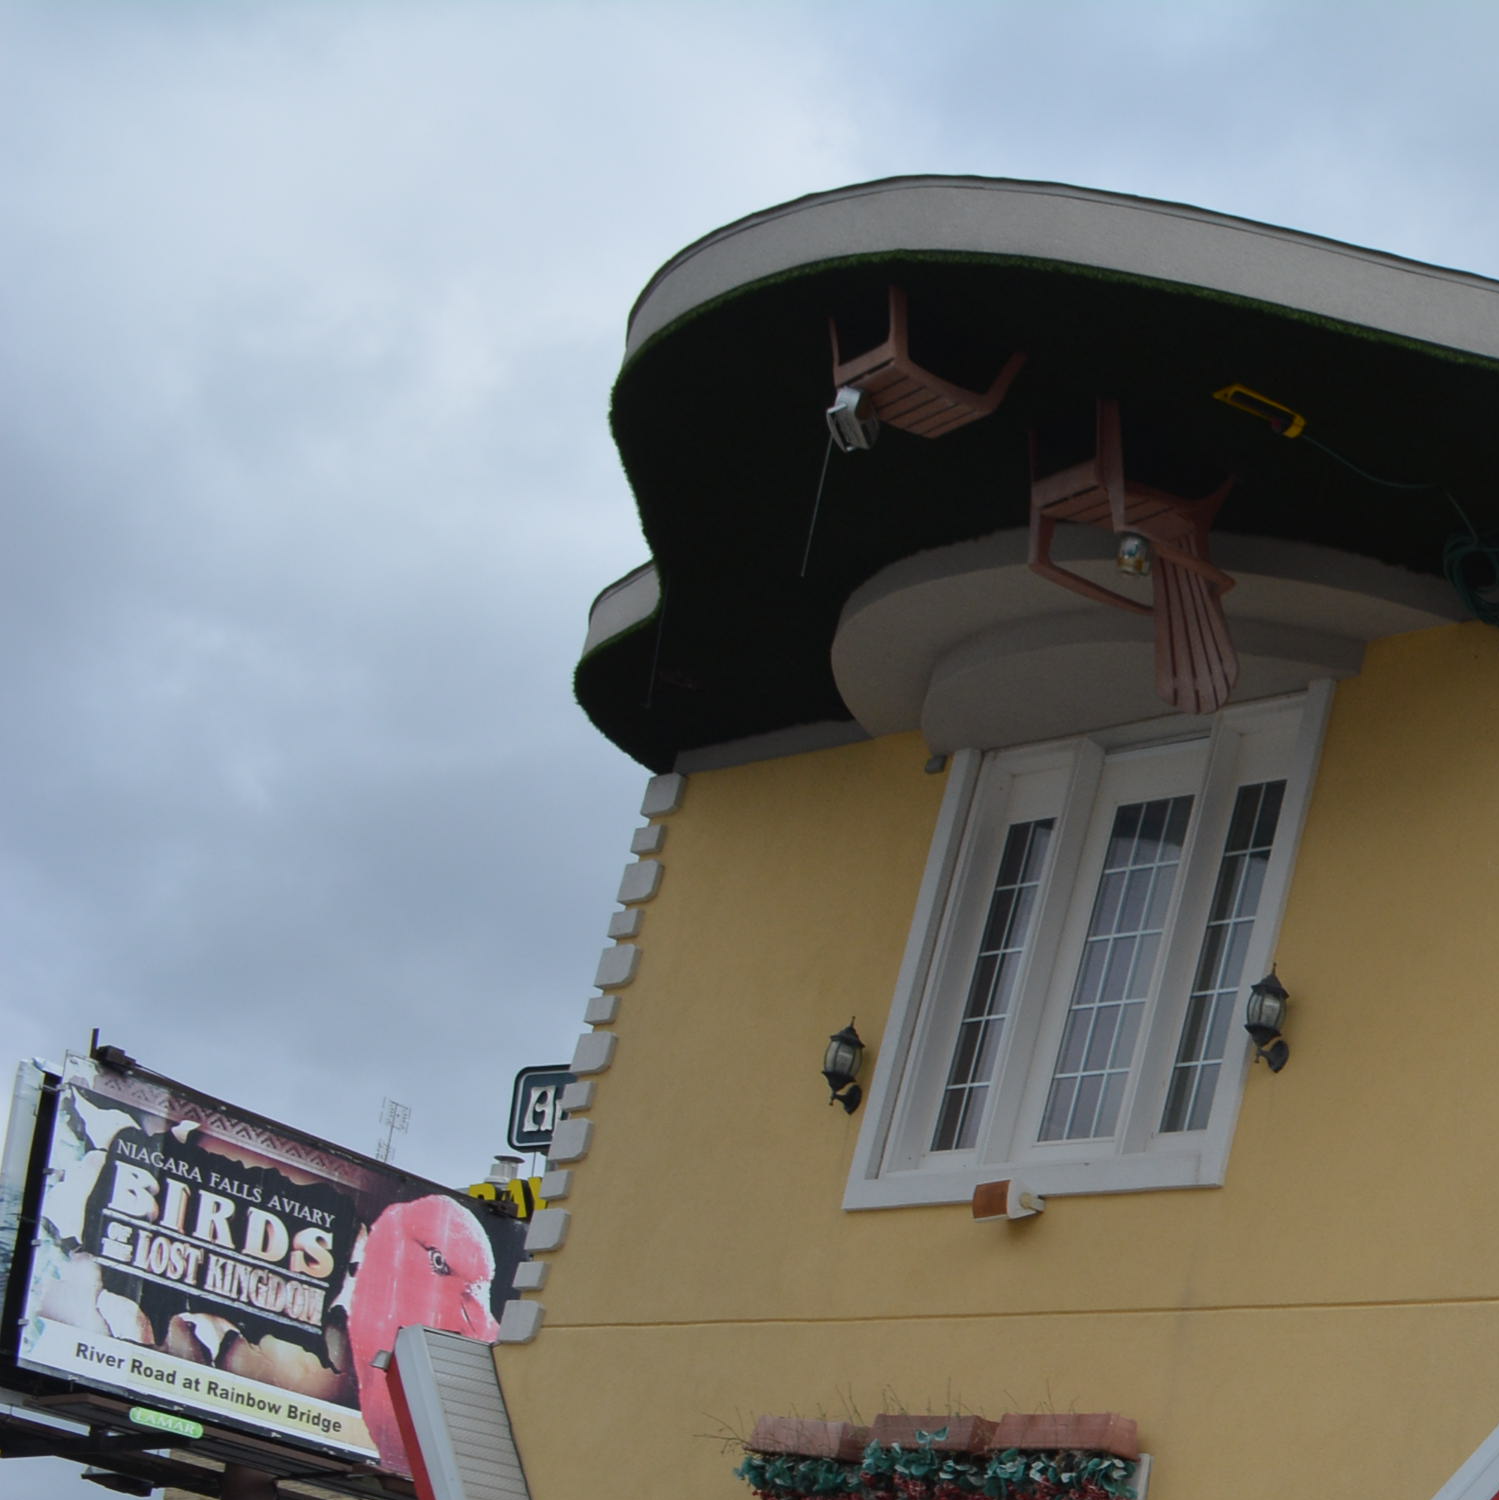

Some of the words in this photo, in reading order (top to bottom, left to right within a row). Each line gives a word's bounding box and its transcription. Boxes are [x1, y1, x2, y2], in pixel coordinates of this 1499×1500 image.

[108, 1160, 334, 1278] BIRDS
[117, 1139, 202, 1183] NIAGARA
[210, 1173, 264, 1203] FALLS
[269, 1195, 335, 1228] AVIARY
[133, 1229, 204, 1285] LOST
[205, 1254, 326, 1326] KINGDOM
[76, 1343, 125, 1369] River
[130, 1358, 177, 1385] Road
[183, 1376, 201, 1392] at
[207, 1381, 282, 1415] Rainbow
[287, 1405, 341, 1433] Bridge
